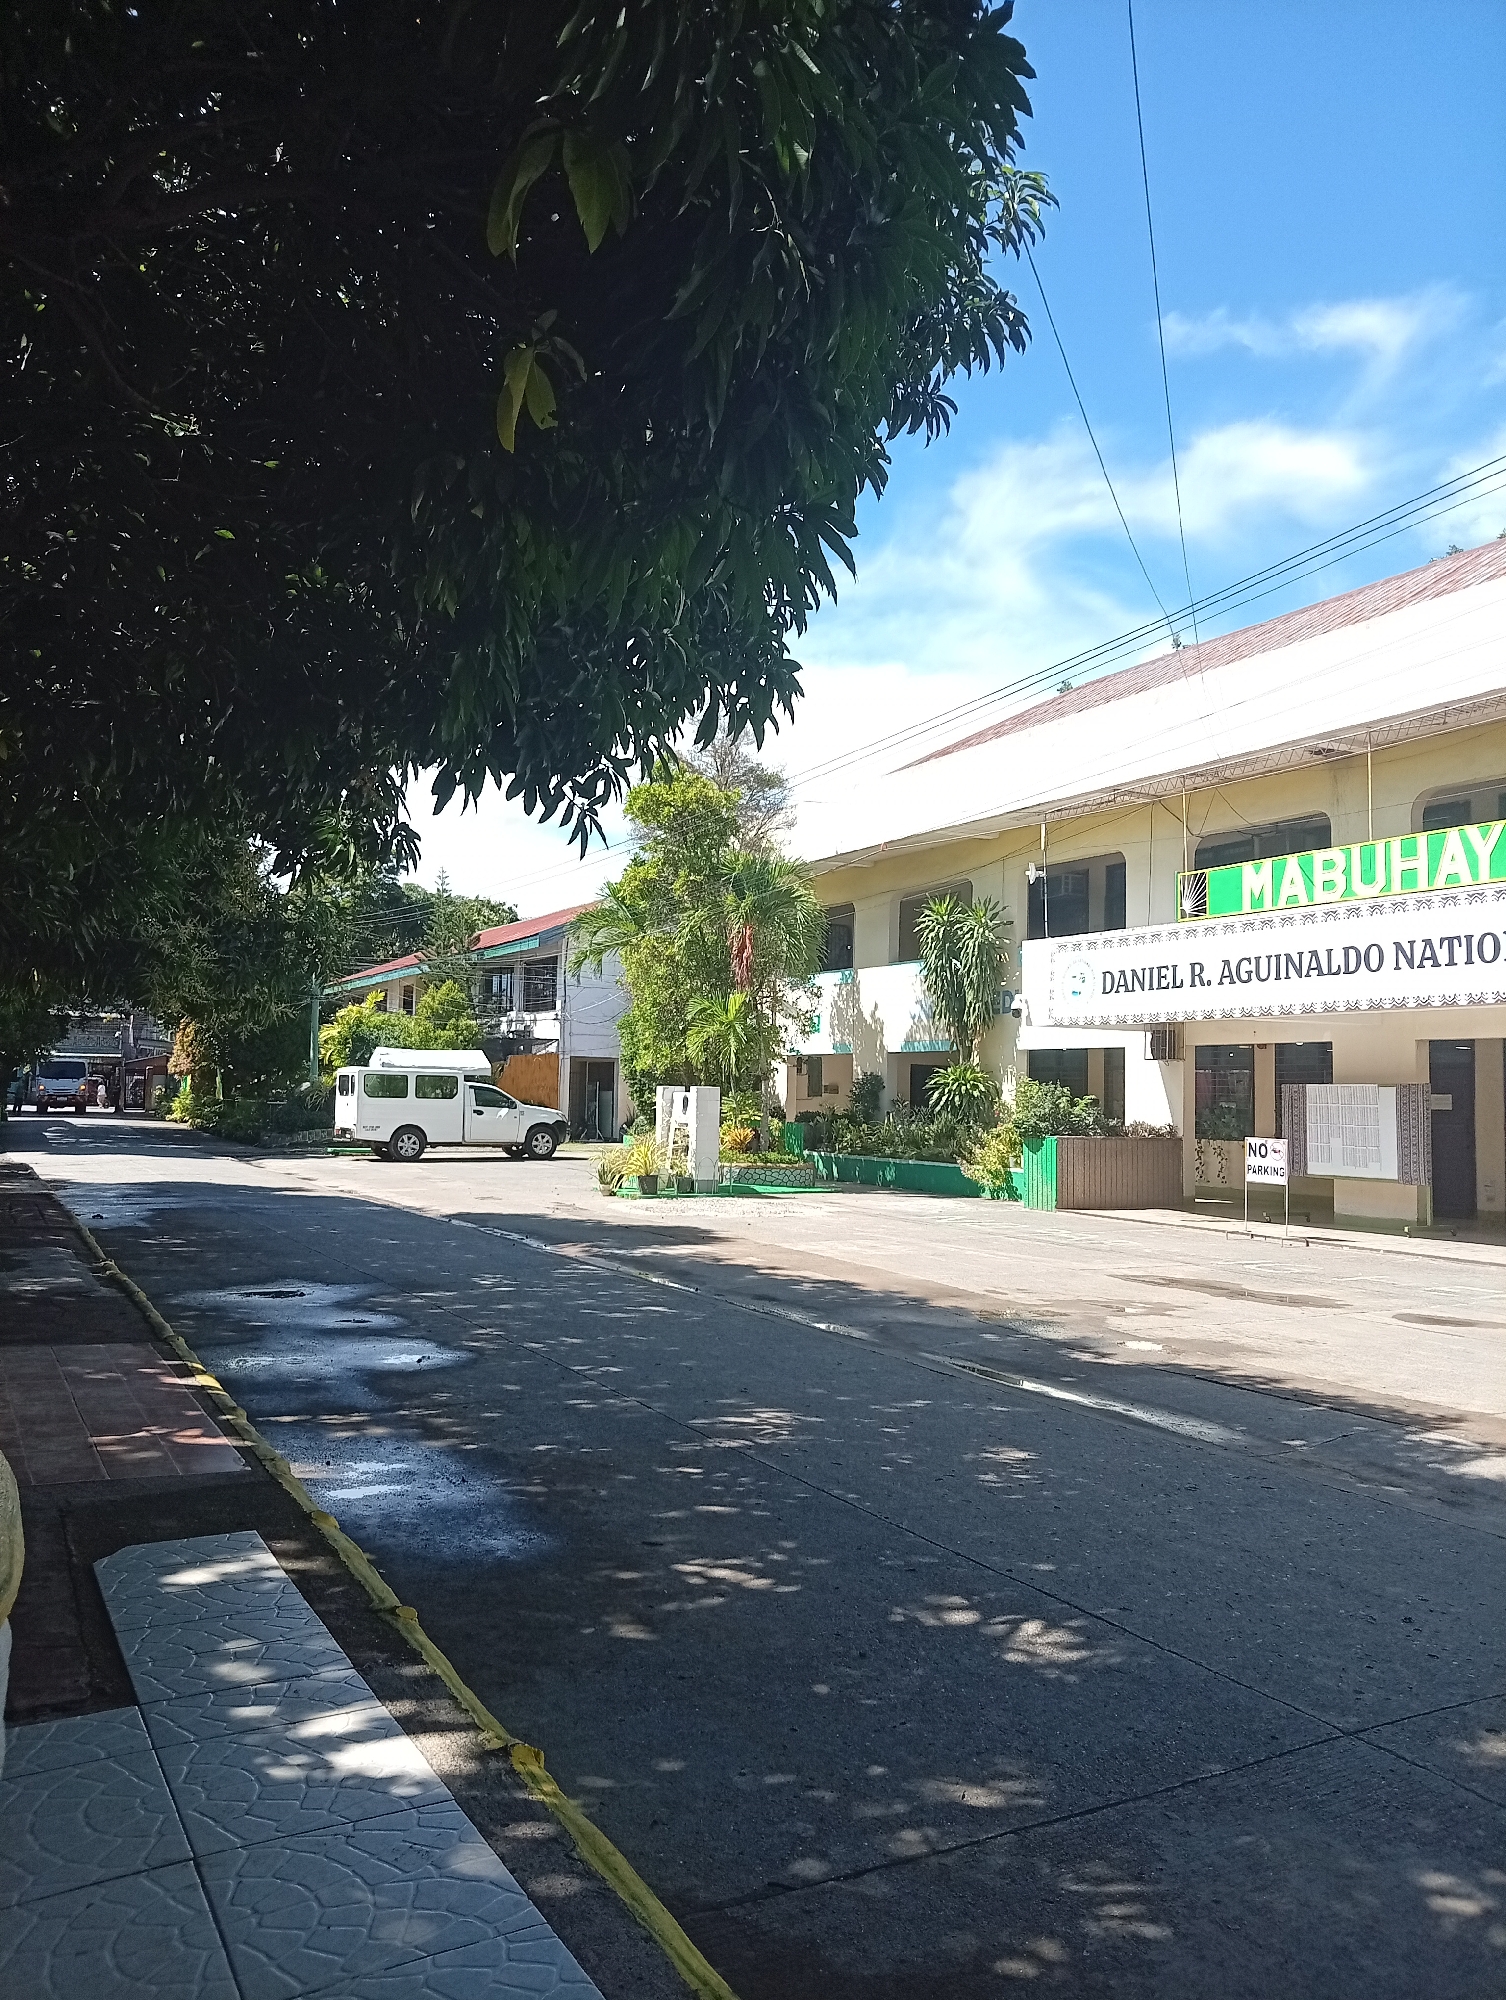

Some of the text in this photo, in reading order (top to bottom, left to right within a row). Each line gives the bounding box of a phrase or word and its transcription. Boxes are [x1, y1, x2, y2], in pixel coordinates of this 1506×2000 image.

[1242, 822, 1505, 913] MABUHAY
[1101, 964, 1184, 995] DANIEL
[1189, 961, 1212, 988] R.
[1218, 943, 1385, 985] AGUINALDO
[1393, 930, 1506, 971] NATIO
[1248, 1142, 1268, 1158] NO
[1247, 1164, 1285, 1178] PARKING
